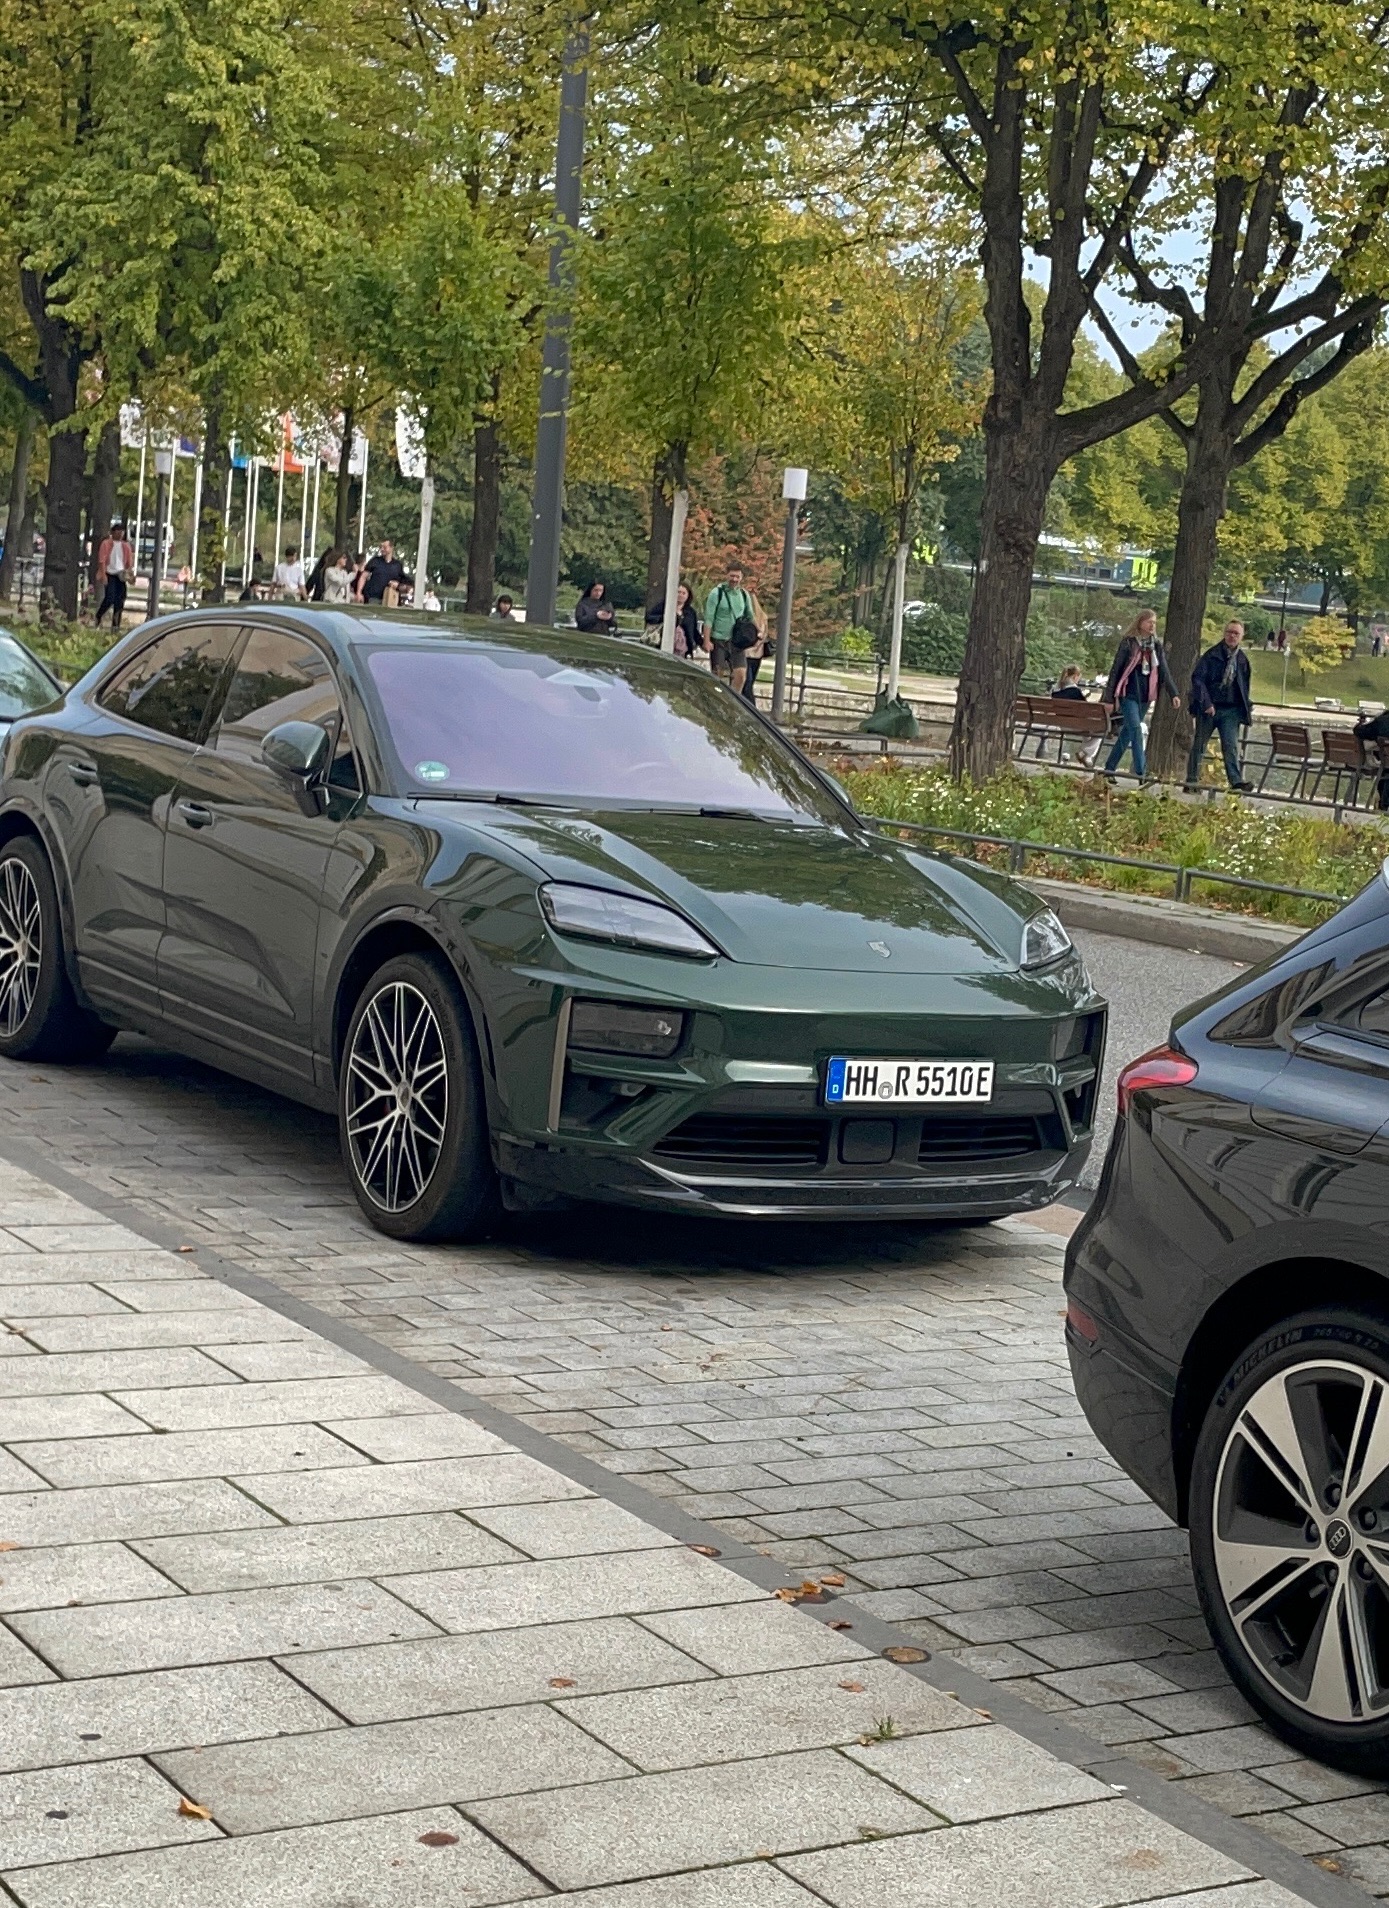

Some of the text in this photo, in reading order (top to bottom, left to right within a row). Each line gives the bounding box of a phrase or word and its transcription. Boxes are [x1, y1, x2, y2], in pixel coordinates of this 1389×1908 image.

[845, 1065, 991, 1097] HH R 5510E
